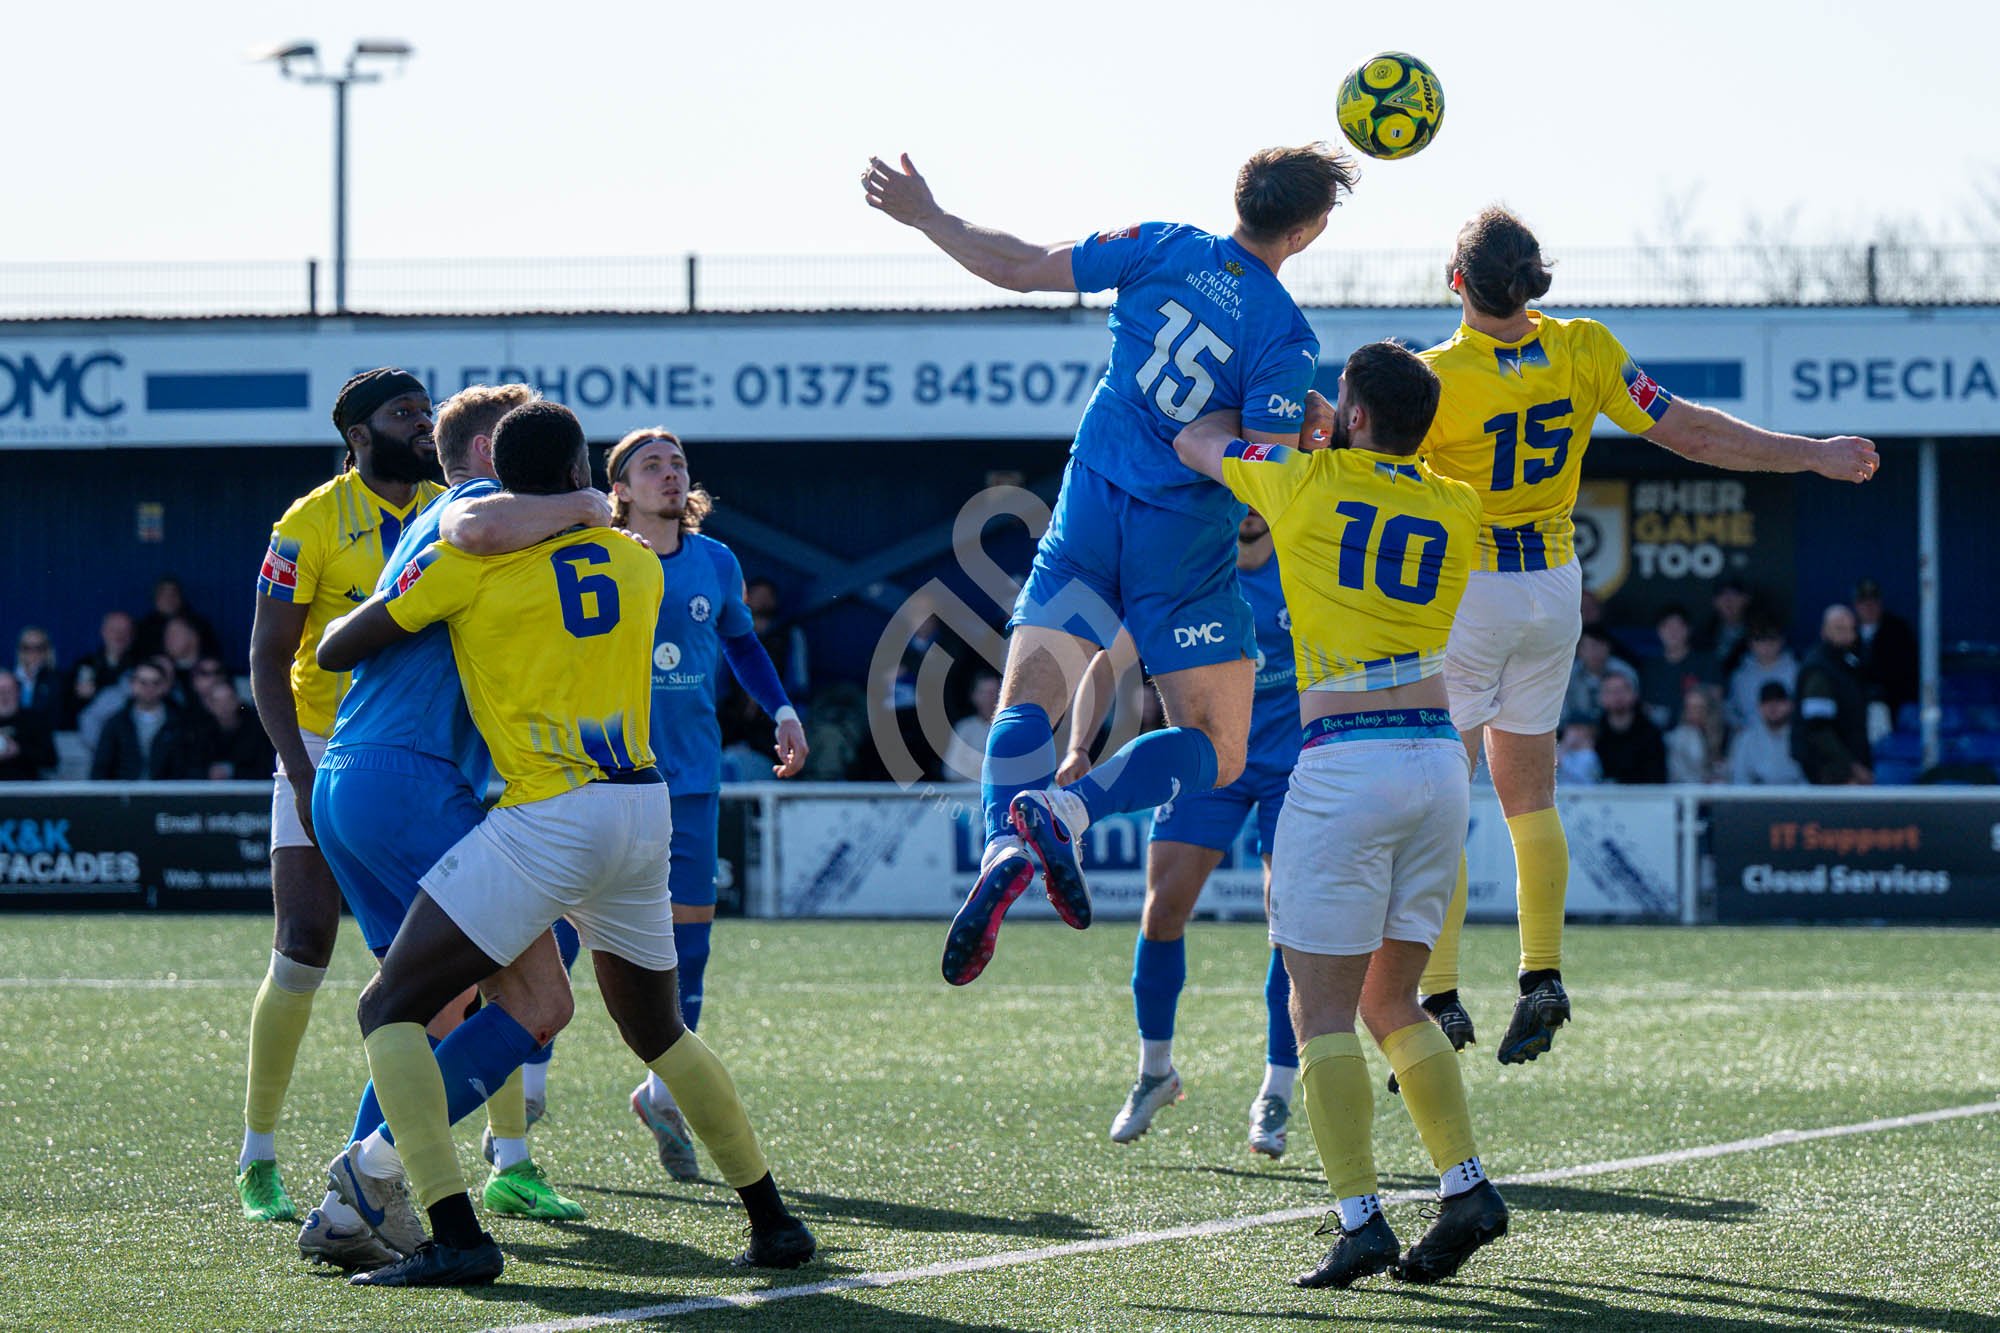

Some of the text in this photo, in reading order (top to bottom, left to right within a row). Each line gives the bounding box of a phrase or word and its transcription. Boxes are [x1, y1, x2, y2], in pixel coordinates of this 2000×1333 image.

[1185, 272, 1244, 321] BILLERICAY
[1200, 270, 1242, 307] CROWN
[1217, 268, 1240, 290] THE
[1134, 299, 1234, 424] 15
[733, 361, 892, 407] 01375
[1483, 397, 1574, 491] 15
[1635, 480, 1745, 512] #HER
[1634, 512, 1755, 544] GAME
[1335, 501, 1448, 606] 10
[1634, 542, 1725, 579] TOO
[550, 542, 620, 638] 6
[1174, 622, 1225, 648] DMC
[1322, 716, 1345, 732] Rick
[1769, 821, 1920, 856] IT Support
[1743, 863, 1951, 894] Cloud Services
